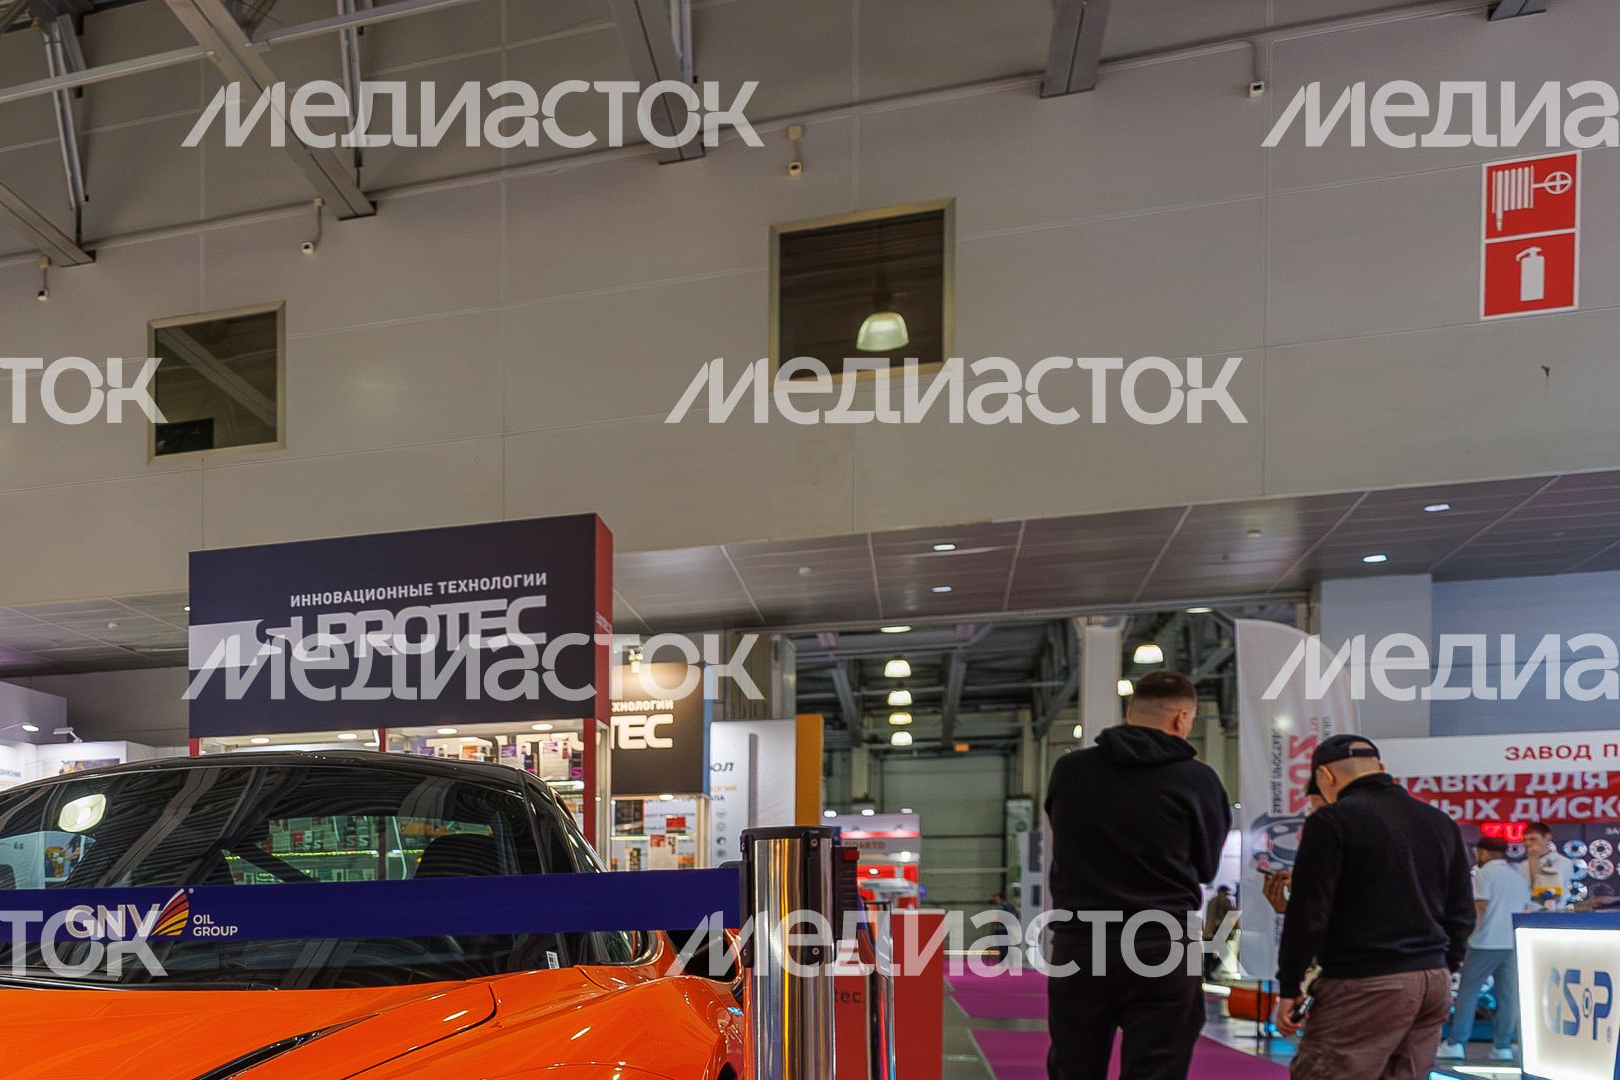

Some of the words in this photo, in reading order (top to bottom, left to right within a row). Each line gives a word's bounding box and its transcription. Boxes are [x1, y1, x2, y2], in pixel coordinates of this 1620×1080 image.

[290, 583, 433, 608] ИННОВАЦИОННЫЕ
[438, 572, 547, 595] ТЕХНОЛОГИИ
[1505, 745, 1592, 761] ЗАВОД
[1430, 798, 1500, 821] ЫХ
[1509, 795, 1620, 822] ДИСК
[65, 904, 160, 938] GNV
[193, 915, 214, 925] OIL
[193, 926, 238, 937] GROUP
